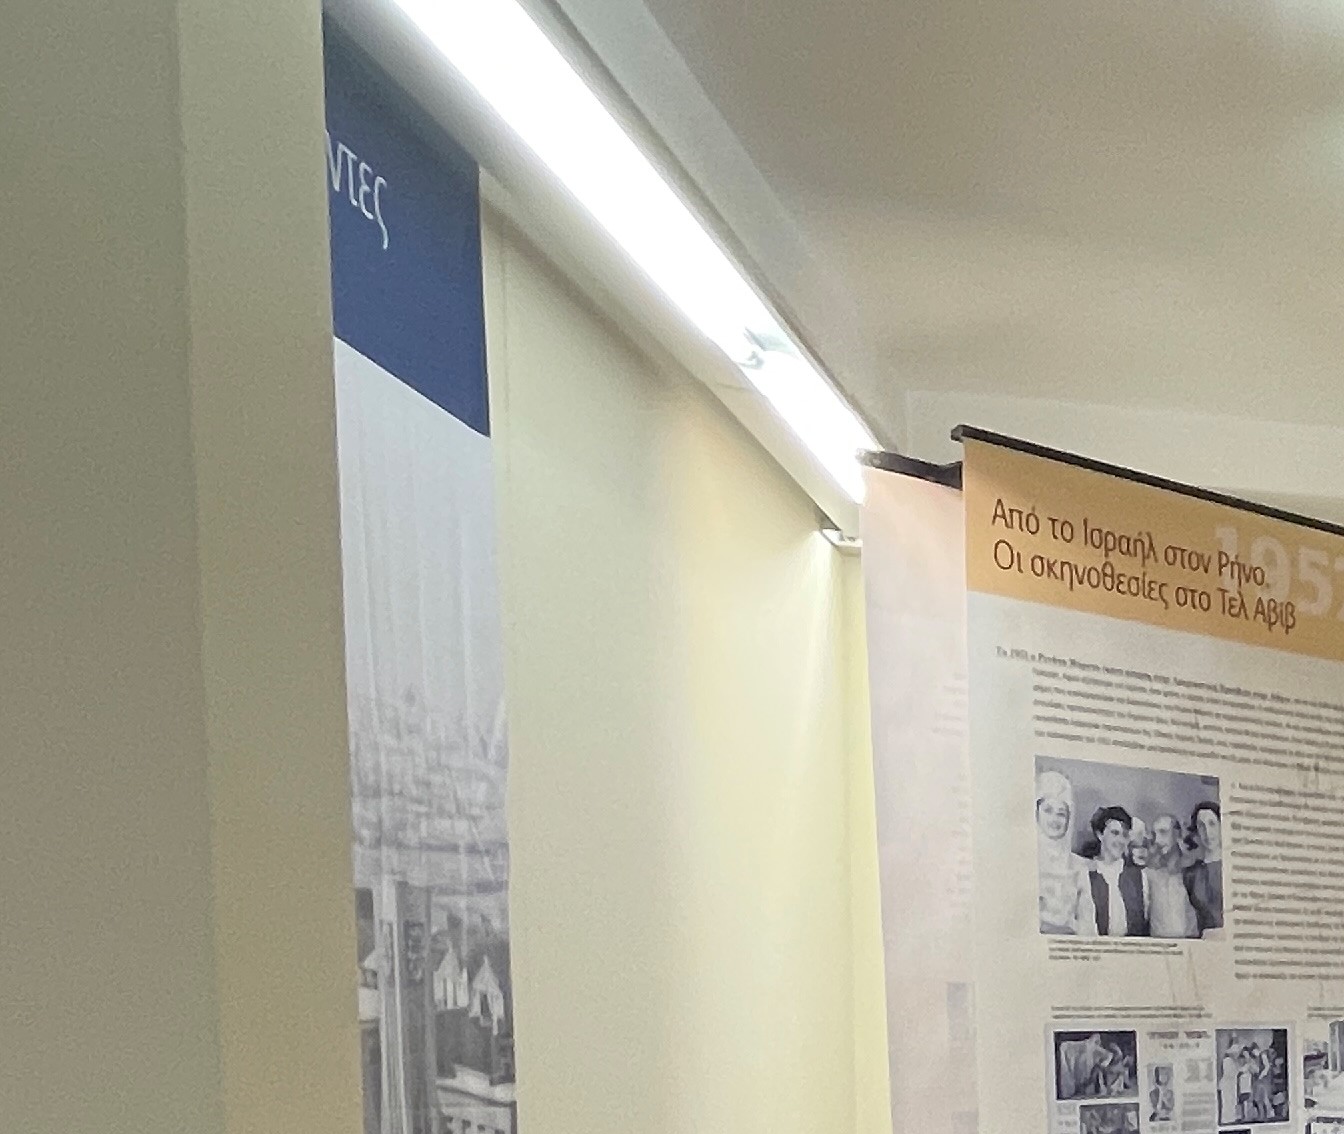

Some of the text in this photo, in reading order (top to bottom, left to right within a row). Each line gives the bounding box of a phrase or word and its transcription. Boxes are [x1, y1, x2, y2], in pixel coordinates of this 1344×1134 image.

[990, 498, 1040, 536] Από
[1048, 518, 1075, 544] το
[1083, 523, 1159, 563] Ισραήλ
[1164, 547, 1211, 575] στον
[993, 539, 1298, 635] Οι σκηνοθεσίες στο Τελ Αβιβ
